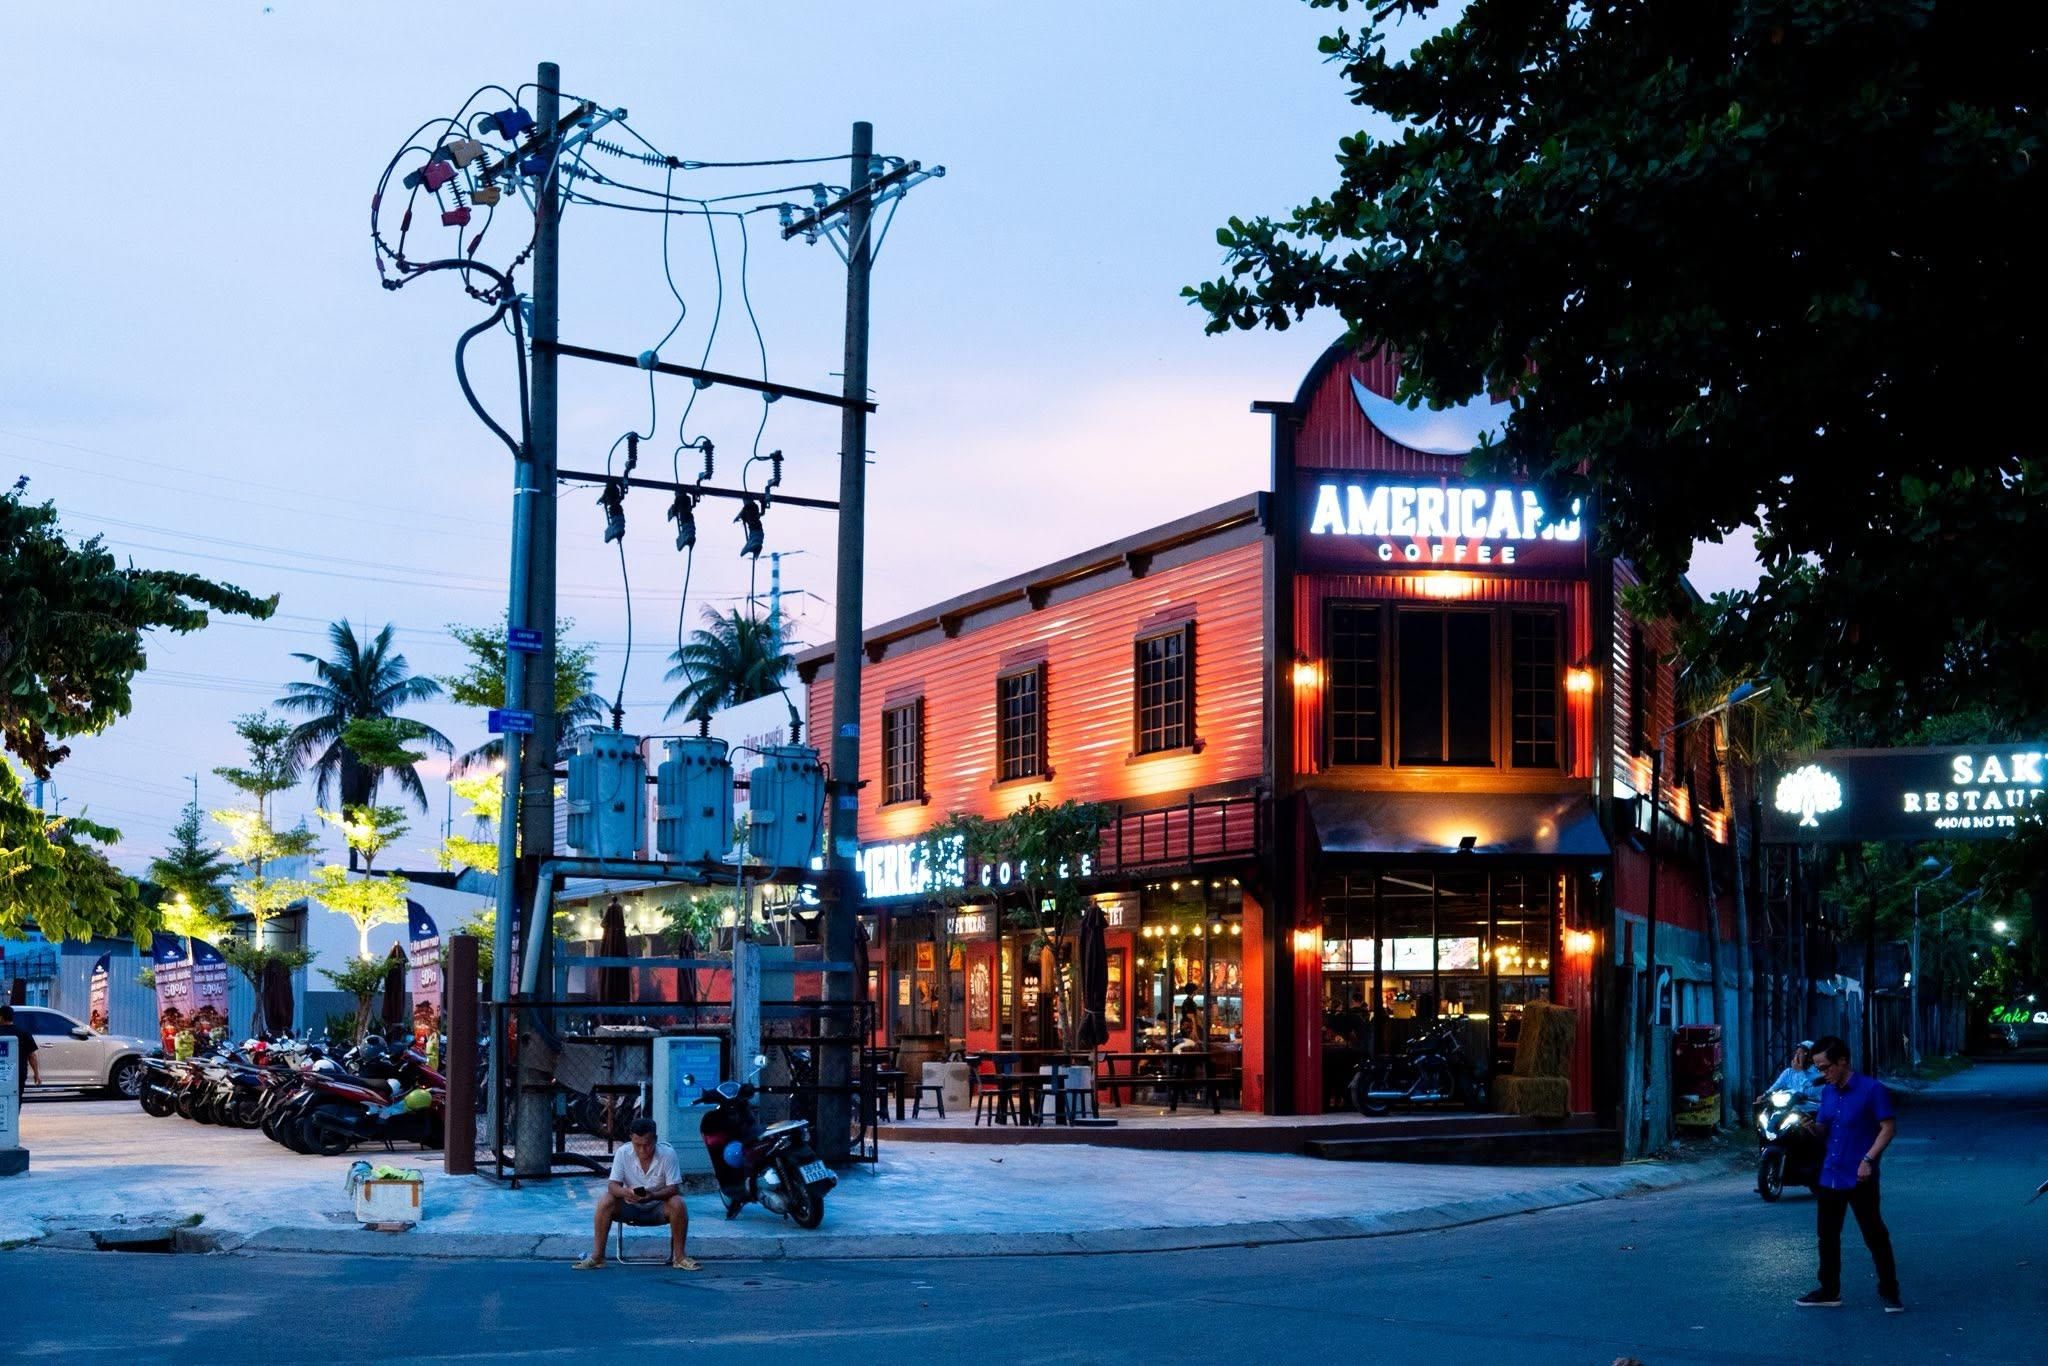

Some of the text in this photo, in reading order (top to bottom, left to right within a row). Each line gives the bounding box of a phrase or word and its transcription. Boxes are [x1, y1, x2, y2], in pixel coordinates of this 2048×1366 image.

[1378, 543, 1516, 563] COFFEE
[1953, 752, 2048, 784] SAK
[164, 983, 187, 997] 50%
[202, 983, 223, 996] 50%
